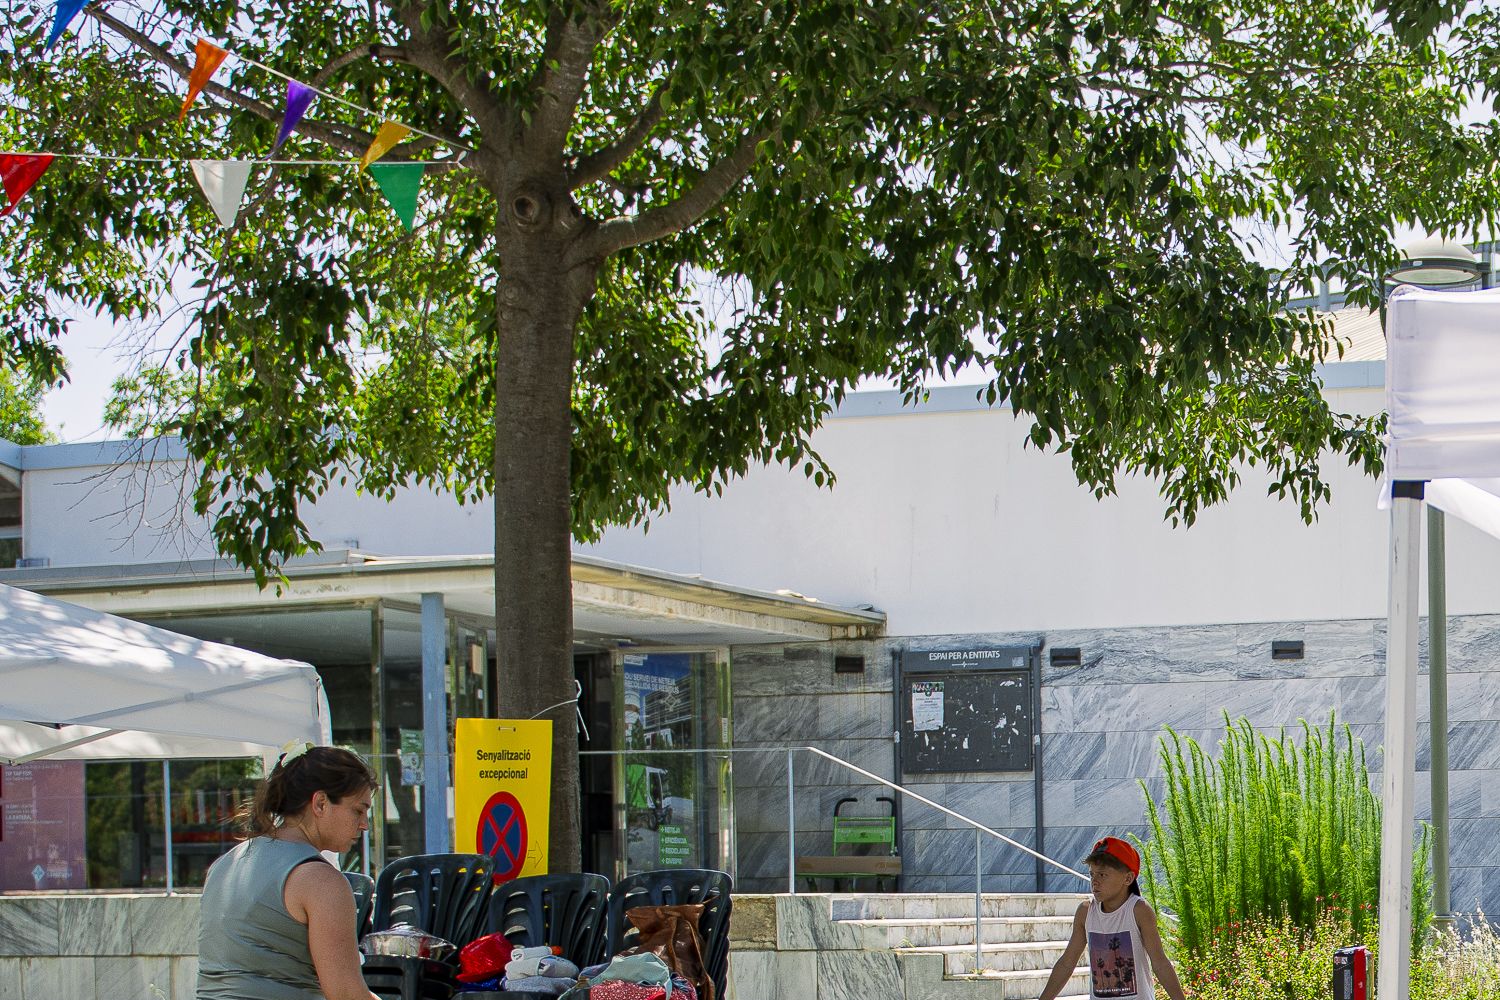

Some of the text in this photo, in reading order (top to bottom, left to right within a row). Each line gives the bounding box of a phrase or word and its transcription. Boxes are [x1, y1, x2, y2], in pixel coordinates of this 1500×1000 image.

[929, 650, 1000, 661] ESPAI PER A ENTITATS
[476, 749, 531, 763] Senyalització
[479, 768, 528, 780] excepcional
